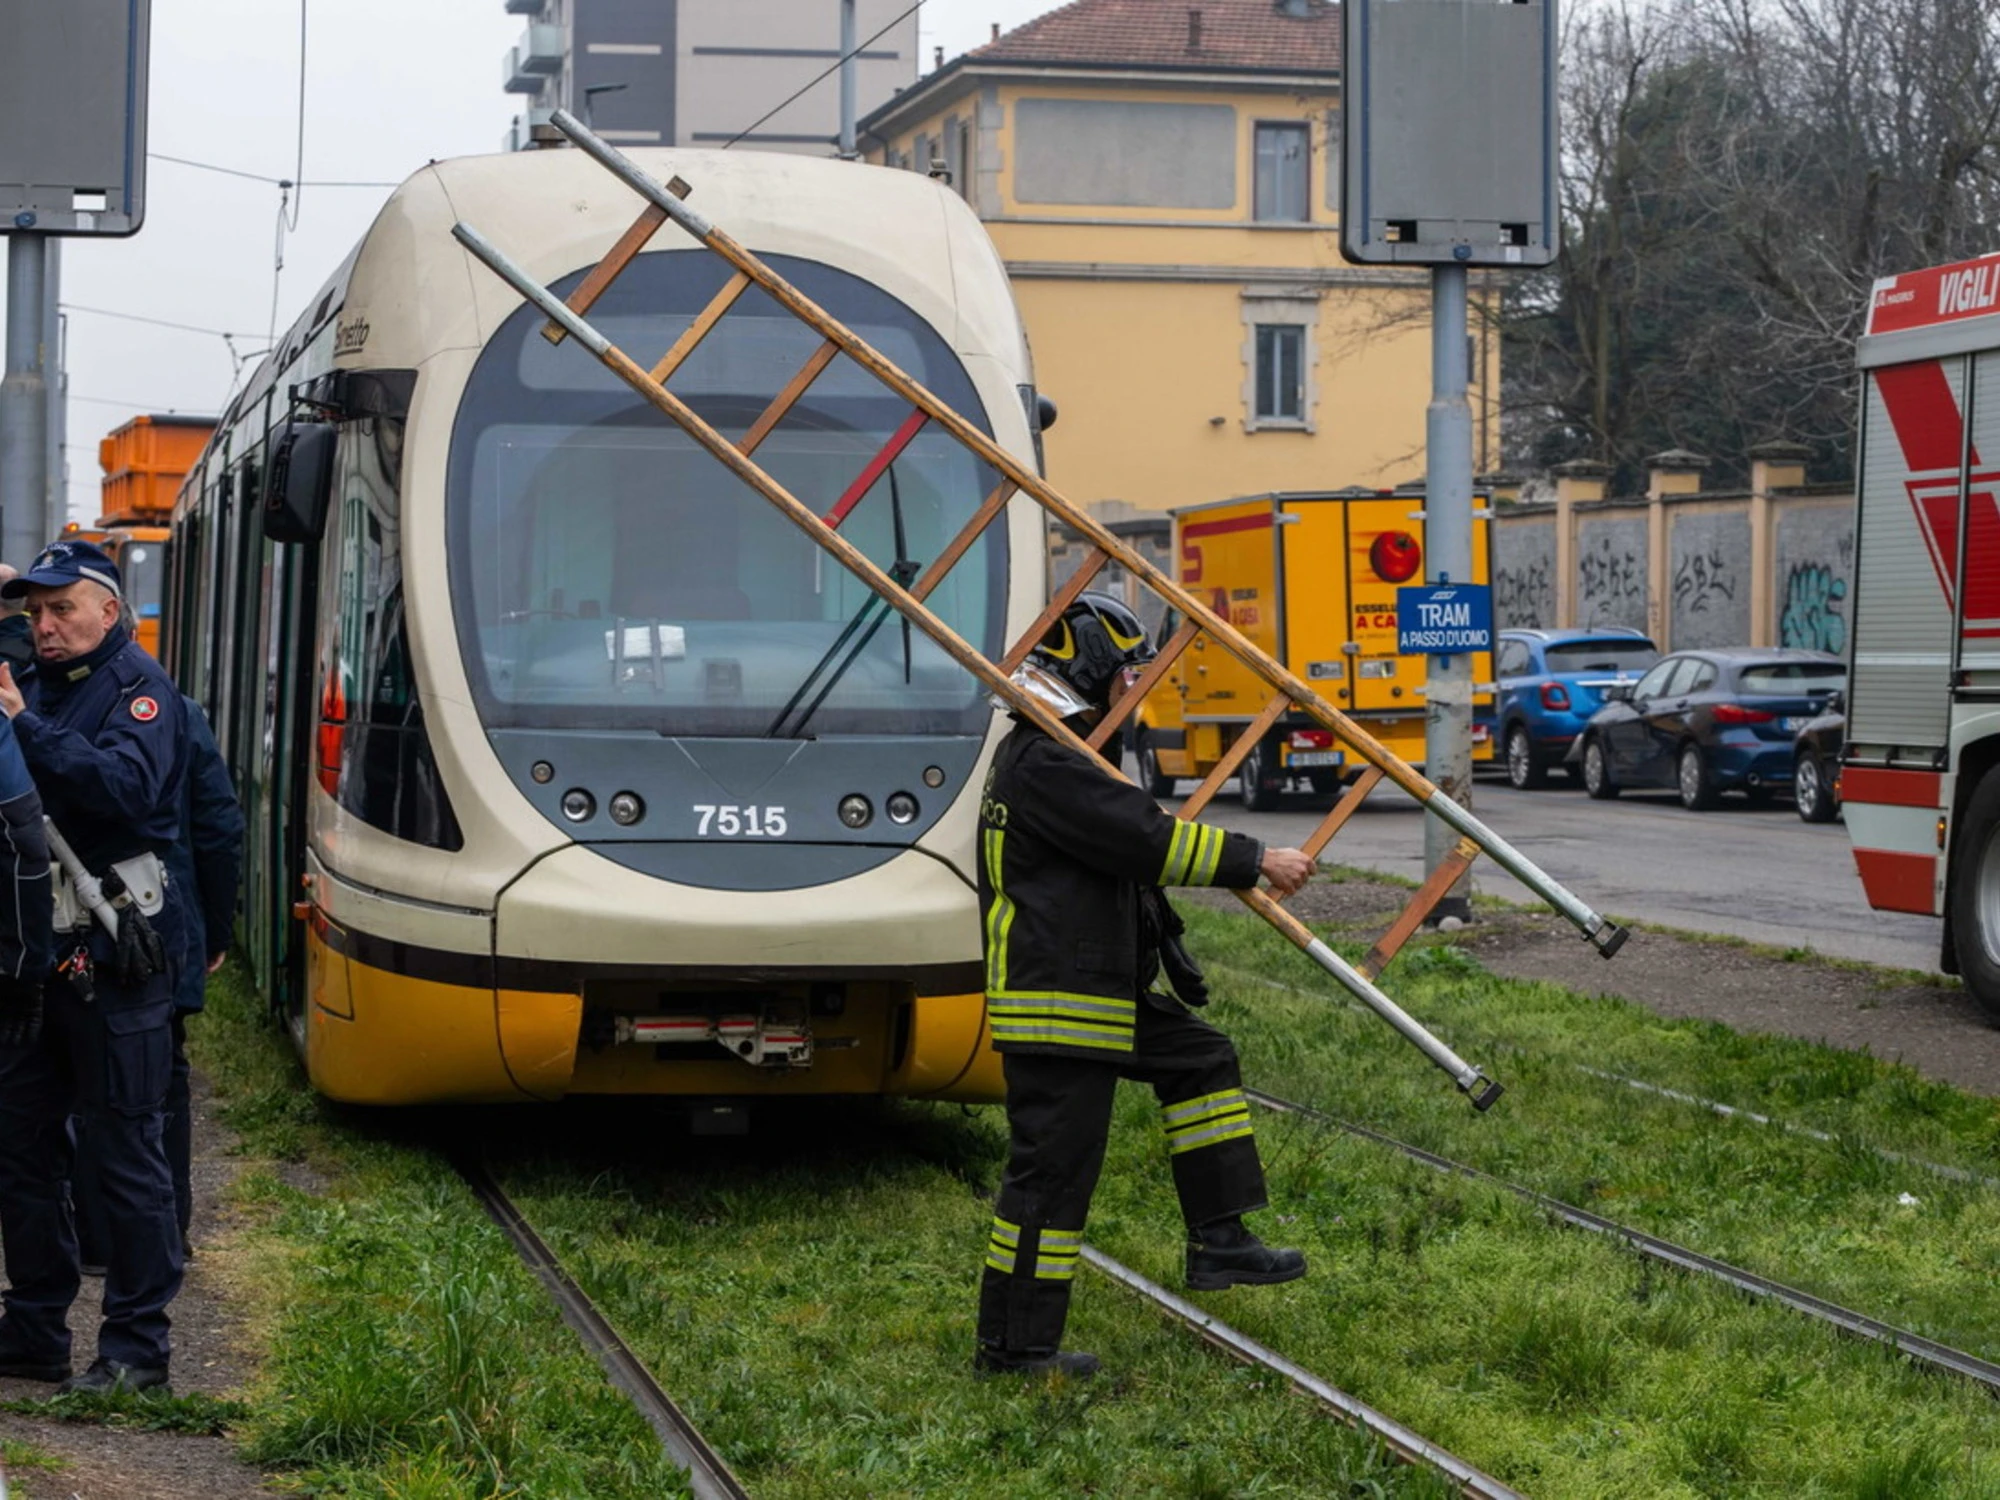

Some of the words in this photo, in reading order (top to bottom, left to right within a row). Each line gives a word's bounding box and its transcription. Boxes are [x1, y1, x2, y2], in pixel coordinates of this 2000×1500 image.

[1938, 262, 2000, 316] VIGILI
[1355, 615, 1368, 629] A
[1417, 603, 1470, 628] TRAM
[1400, 631, 1409, 648] A
[1409, 630, 1446, 648] PASSO
[1446, 629, 1490, 647] D'UOMO
[692, 804, 788, 837] 7515
